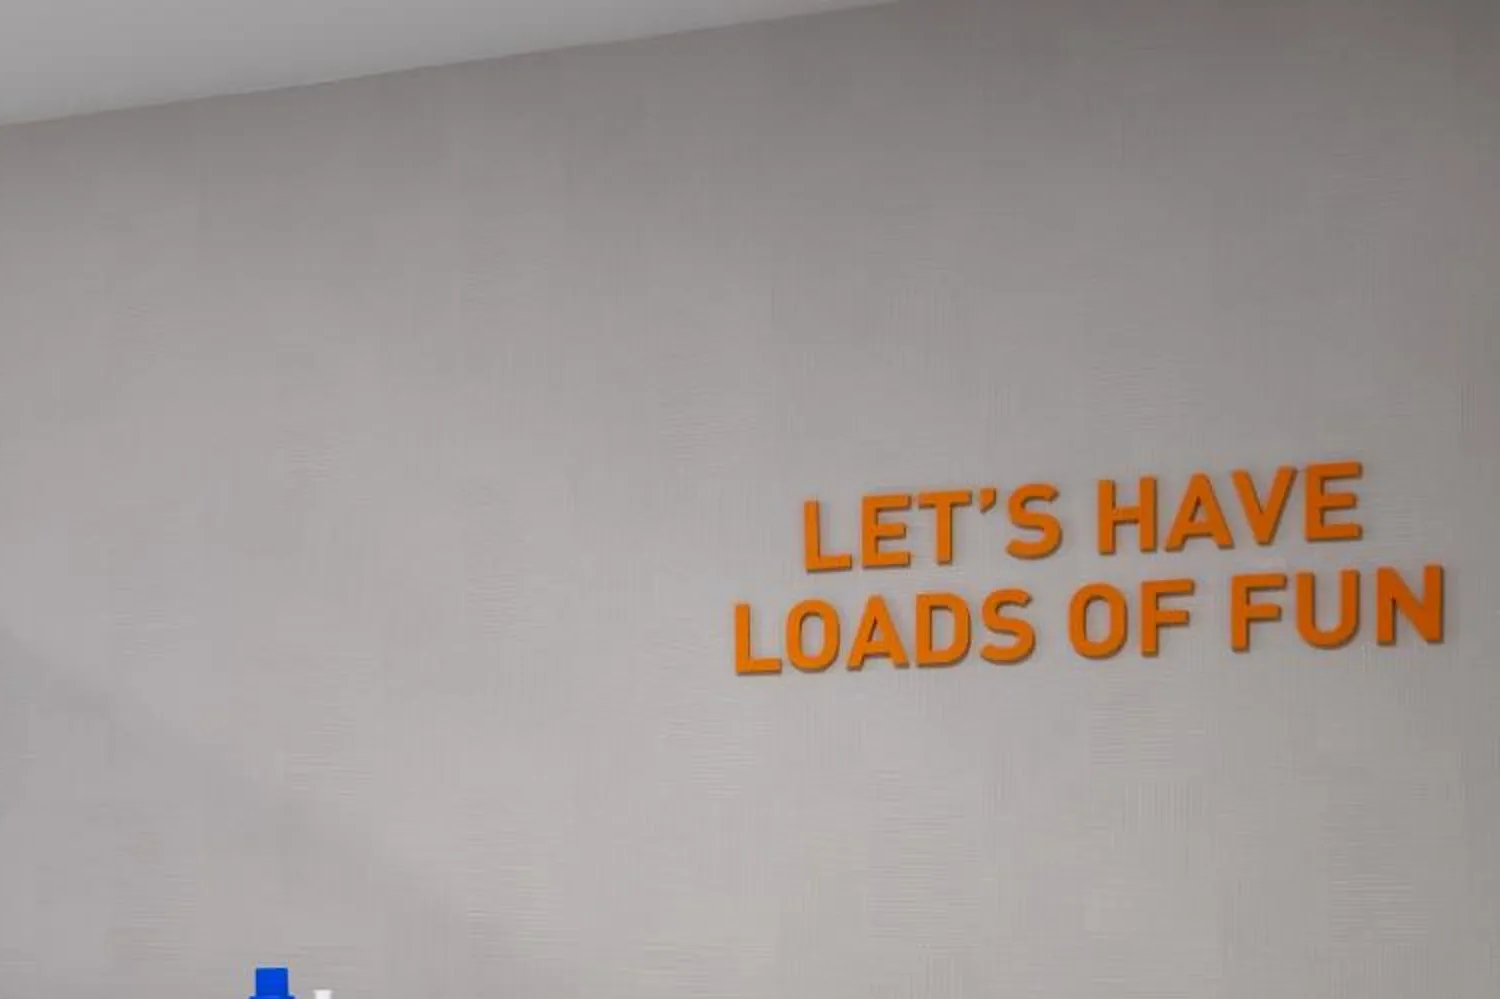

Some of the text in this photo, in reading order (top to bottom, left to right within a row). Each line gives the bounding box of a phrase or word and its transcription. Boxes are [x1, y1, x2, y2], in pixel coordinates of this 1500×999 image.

[802, 459, 1363, 573] LET'S HAVE
[733, 562, 1443, 674] LOADS OF FUN
